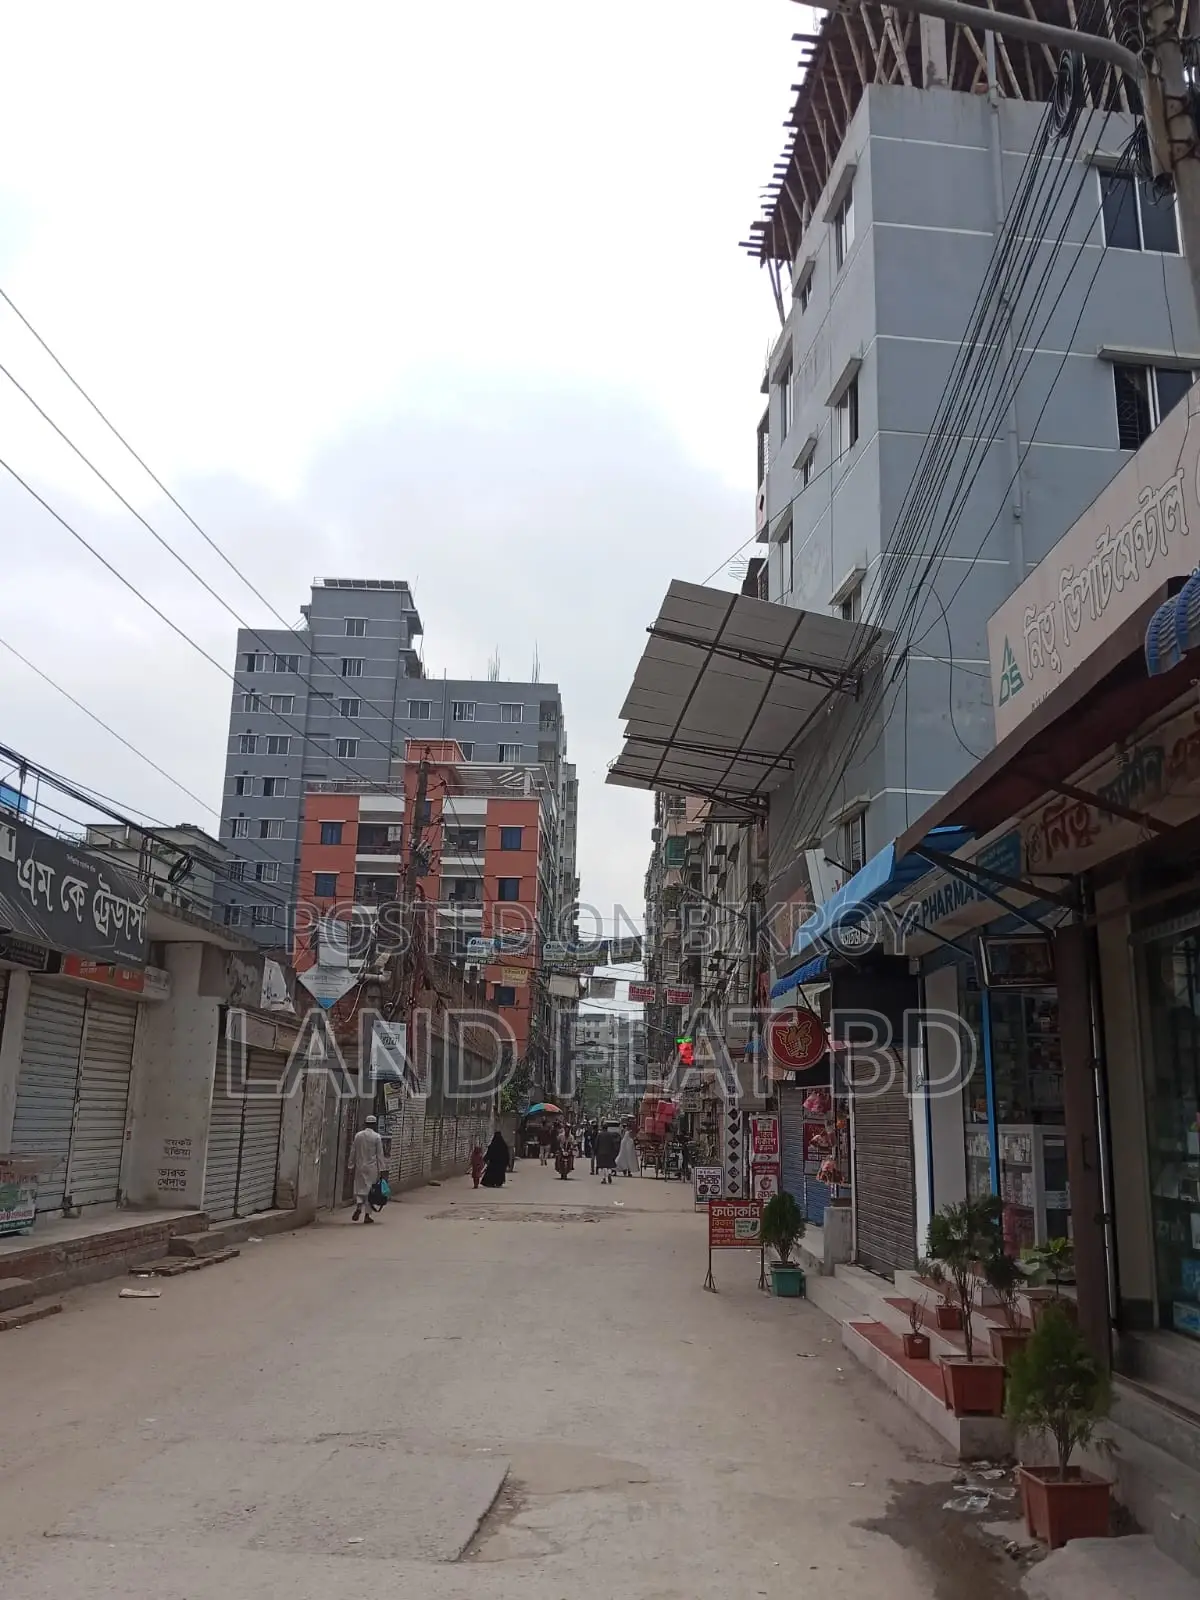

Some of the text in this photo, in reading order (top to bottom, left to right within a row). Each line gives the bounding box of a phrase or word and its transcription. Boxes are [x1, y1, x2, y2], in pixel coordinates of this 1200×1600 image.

[17, 858, 148, 944] এম কে ট্রেডার্স
